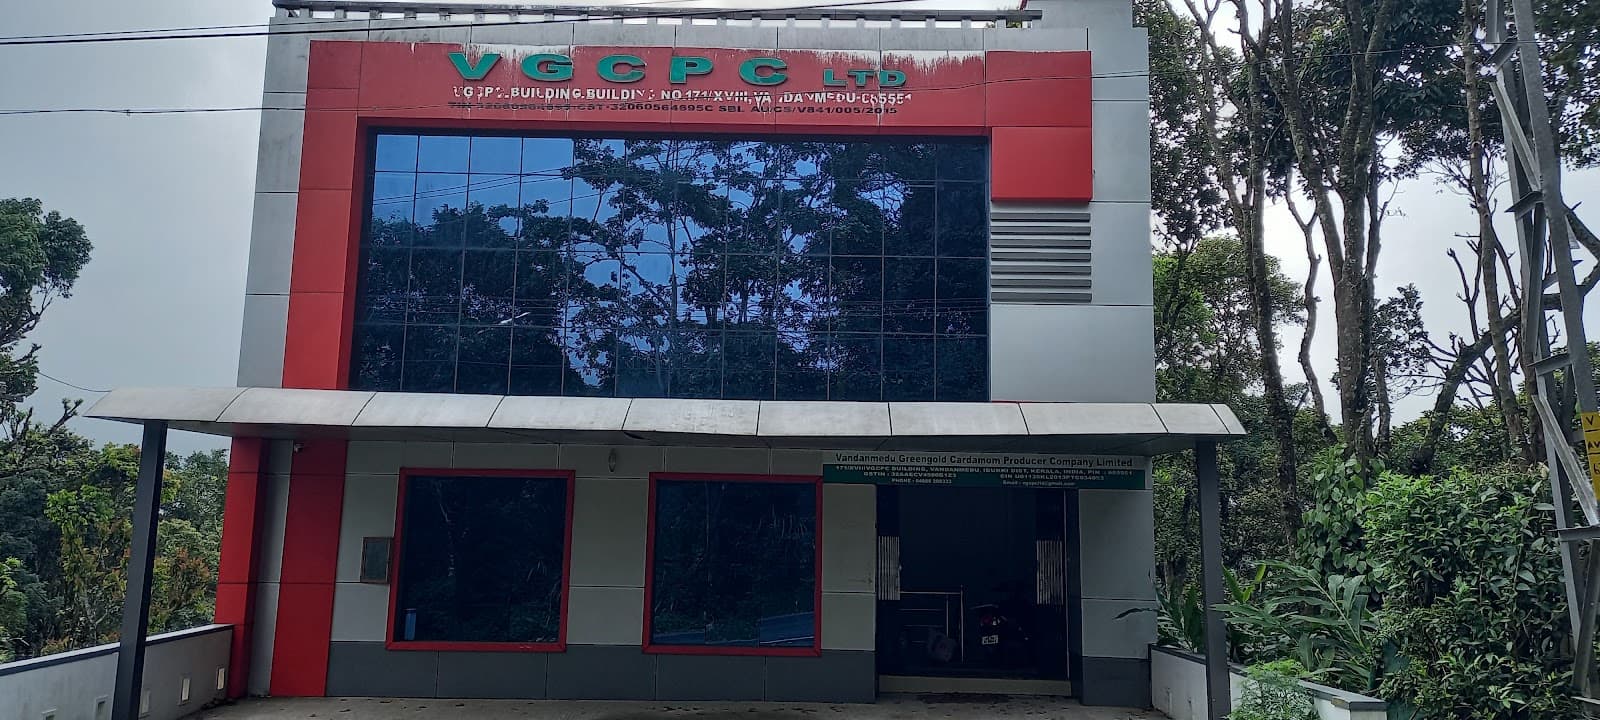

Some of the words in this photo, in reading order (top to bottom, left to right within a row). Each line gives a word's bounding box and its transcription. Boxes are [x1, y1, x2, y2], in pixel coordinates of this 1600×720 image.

[823, 68, 907, 88] LTD
[718, 105, 745, 113] SBL
[835, 453, 896, 463] Vandanmedu
[899, 454, 947, 465] Greengold
[949, 455, 1000, 464] Cardamom
[1003, 456, 1047, 465] Producer
[1049, 457, 1093, 468] Company
[1096, 457, 1133, 467] Limited
